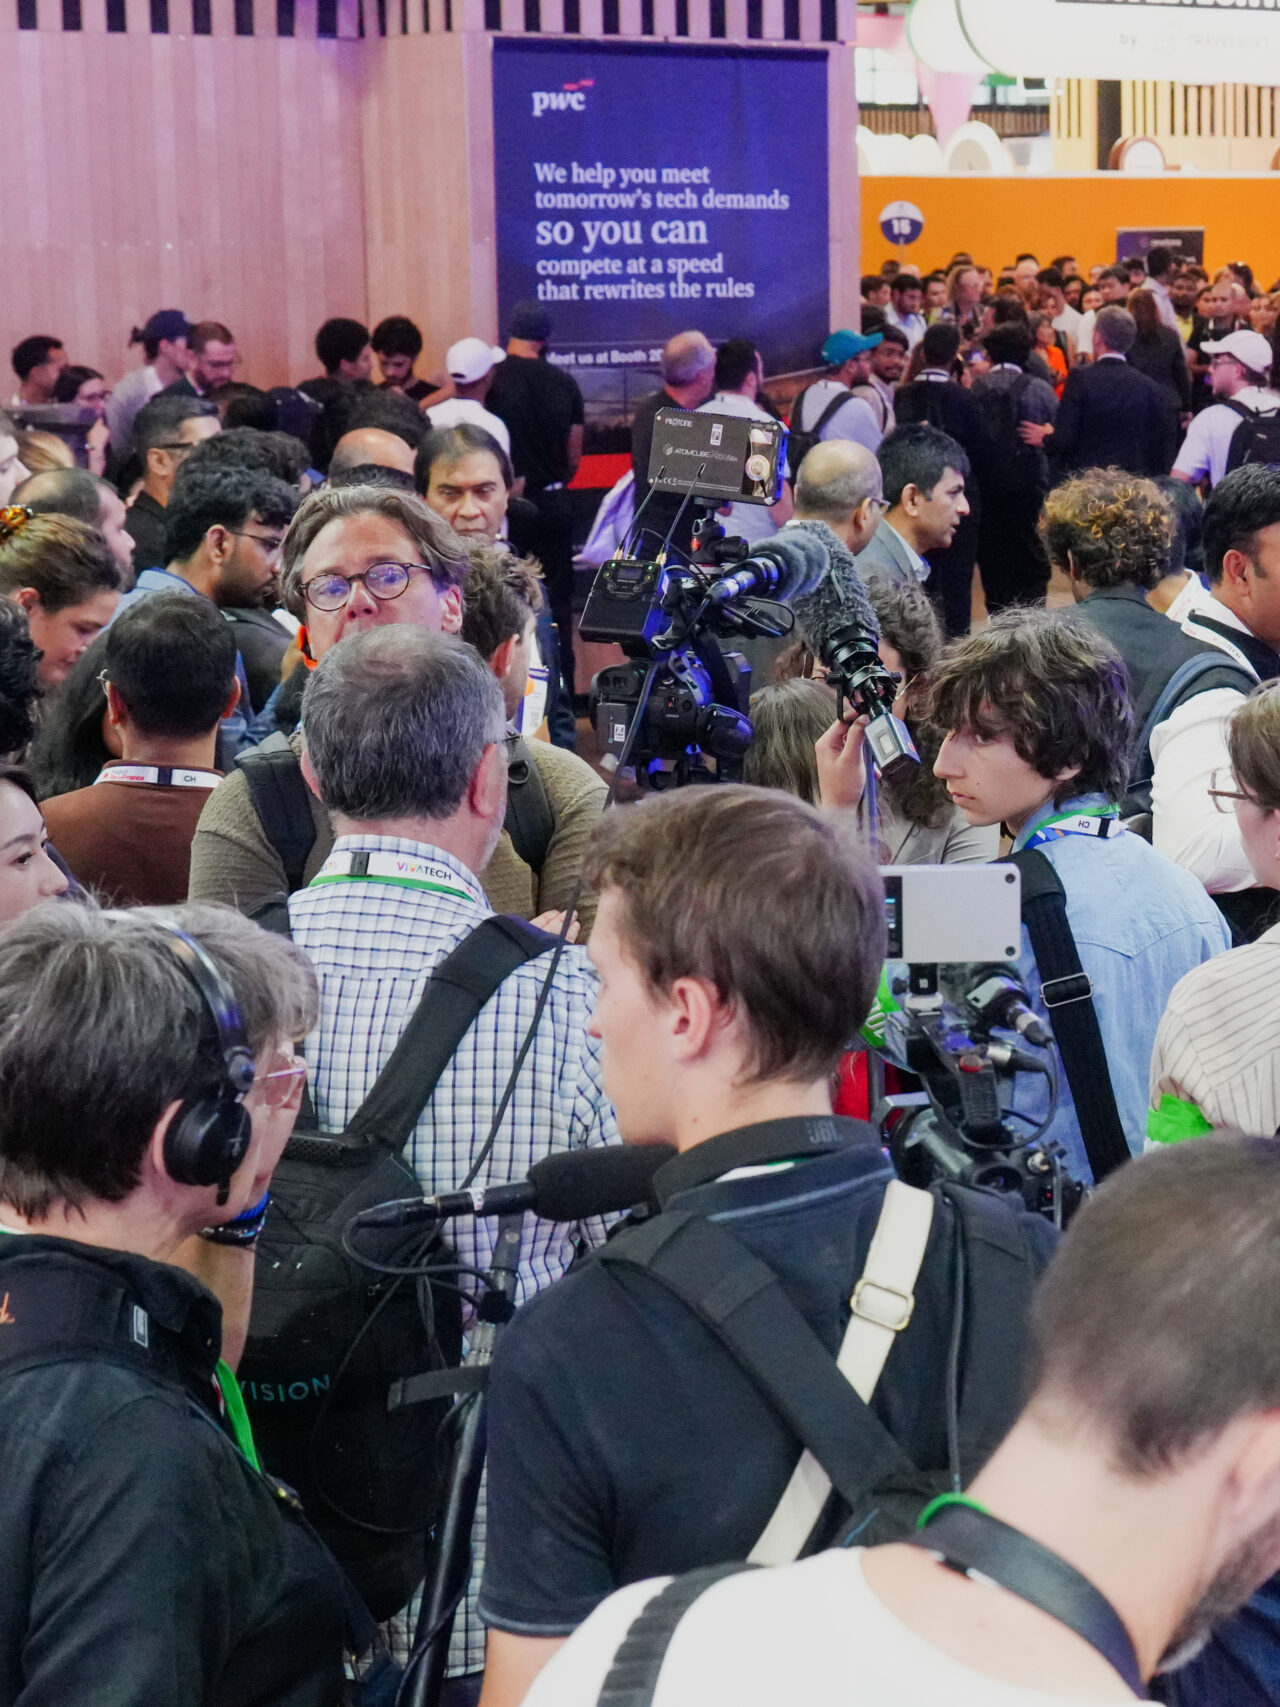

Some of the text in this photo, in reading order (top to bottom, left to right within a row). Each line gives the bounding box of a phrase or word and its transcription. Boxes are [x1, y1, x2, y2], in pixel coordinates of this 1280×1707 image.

[532, 91, 586, 117] pwc
[534, 162, 710, 189] We help you meet
[656, 188, 699, 209] tech
[702, 189, 790, 210] demands
[536, 220, 708, 253] so you can
[536, 253, 724, 281] compete at a speed
[537, 277, 755, 301] that rewrites the rules
[610, 350, 648, 363] Booth
[183, 775, 197, 783] CH
[396, 861, 452, 881] VIVATECH
